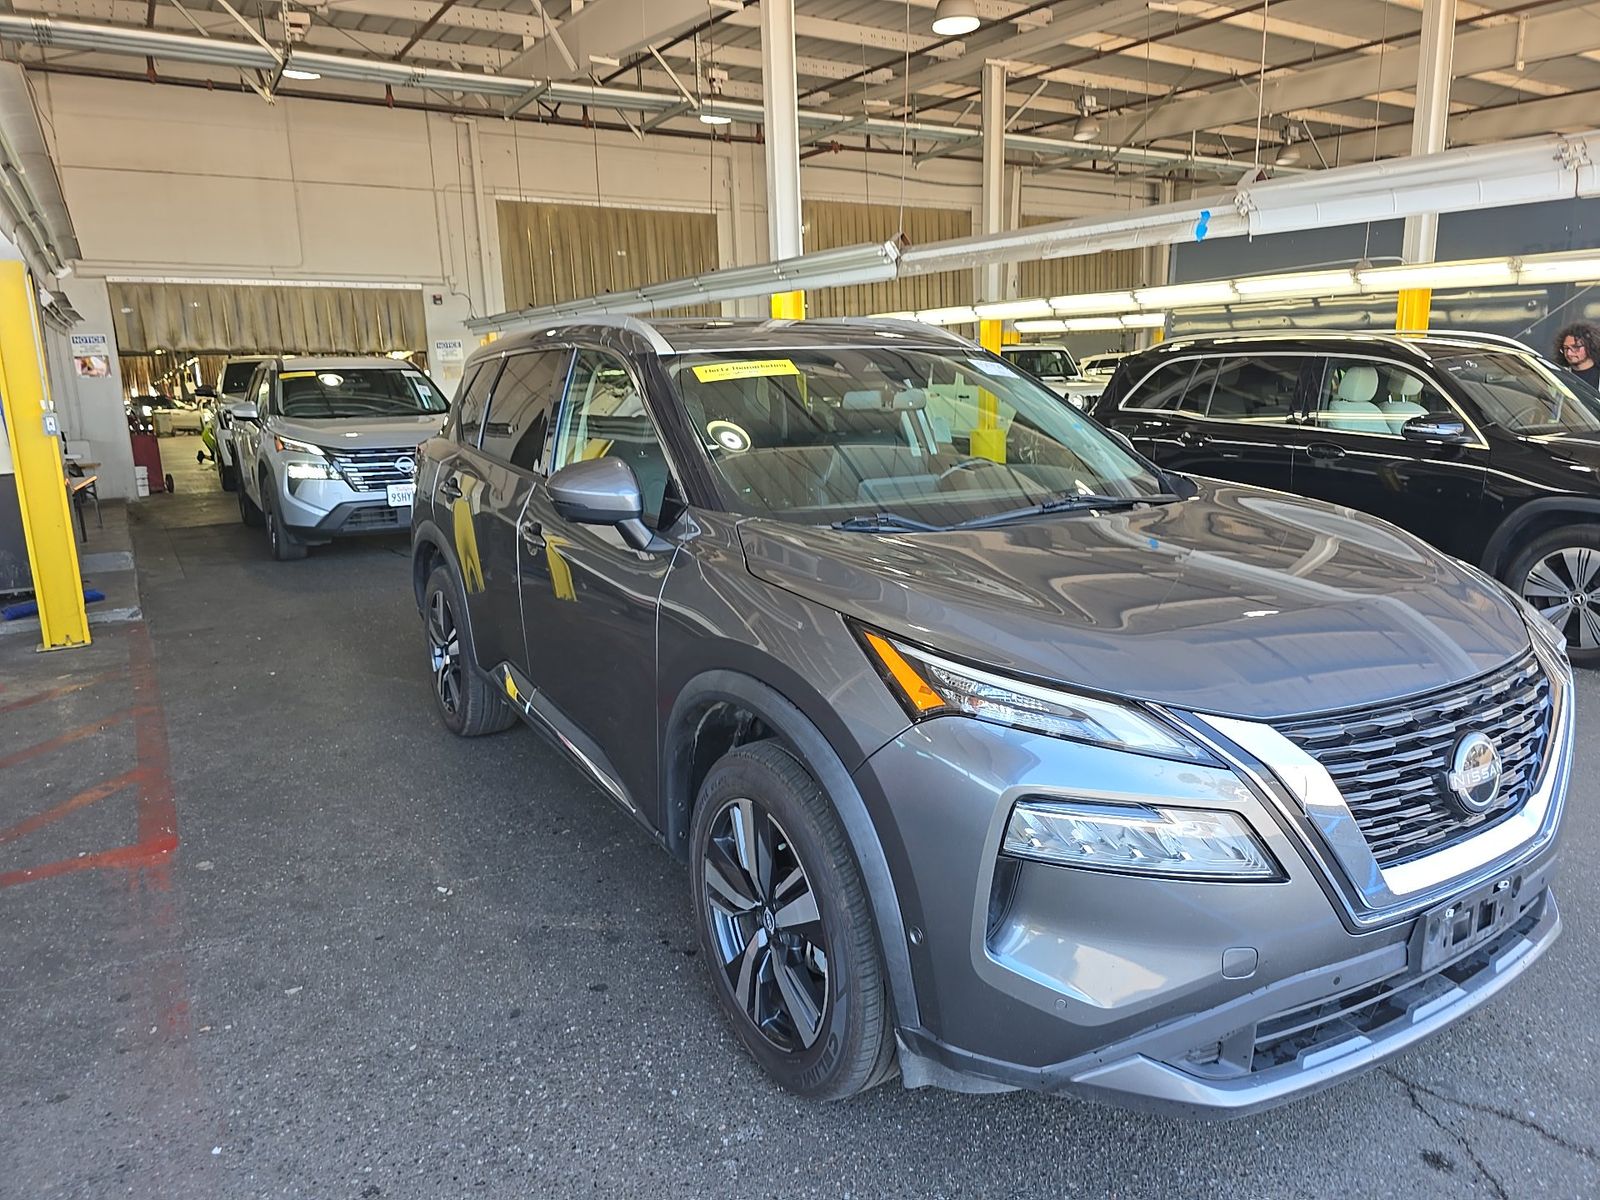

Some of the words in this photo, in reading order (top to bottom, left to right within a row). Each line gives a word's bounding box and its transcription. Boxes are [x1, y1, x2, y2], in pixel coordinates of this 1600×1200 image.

[73, 336, 105, 344] NOTICE
[437, 341, 461, 349] NOTICE
[1453, 761, 1502, 787] NISSAN
